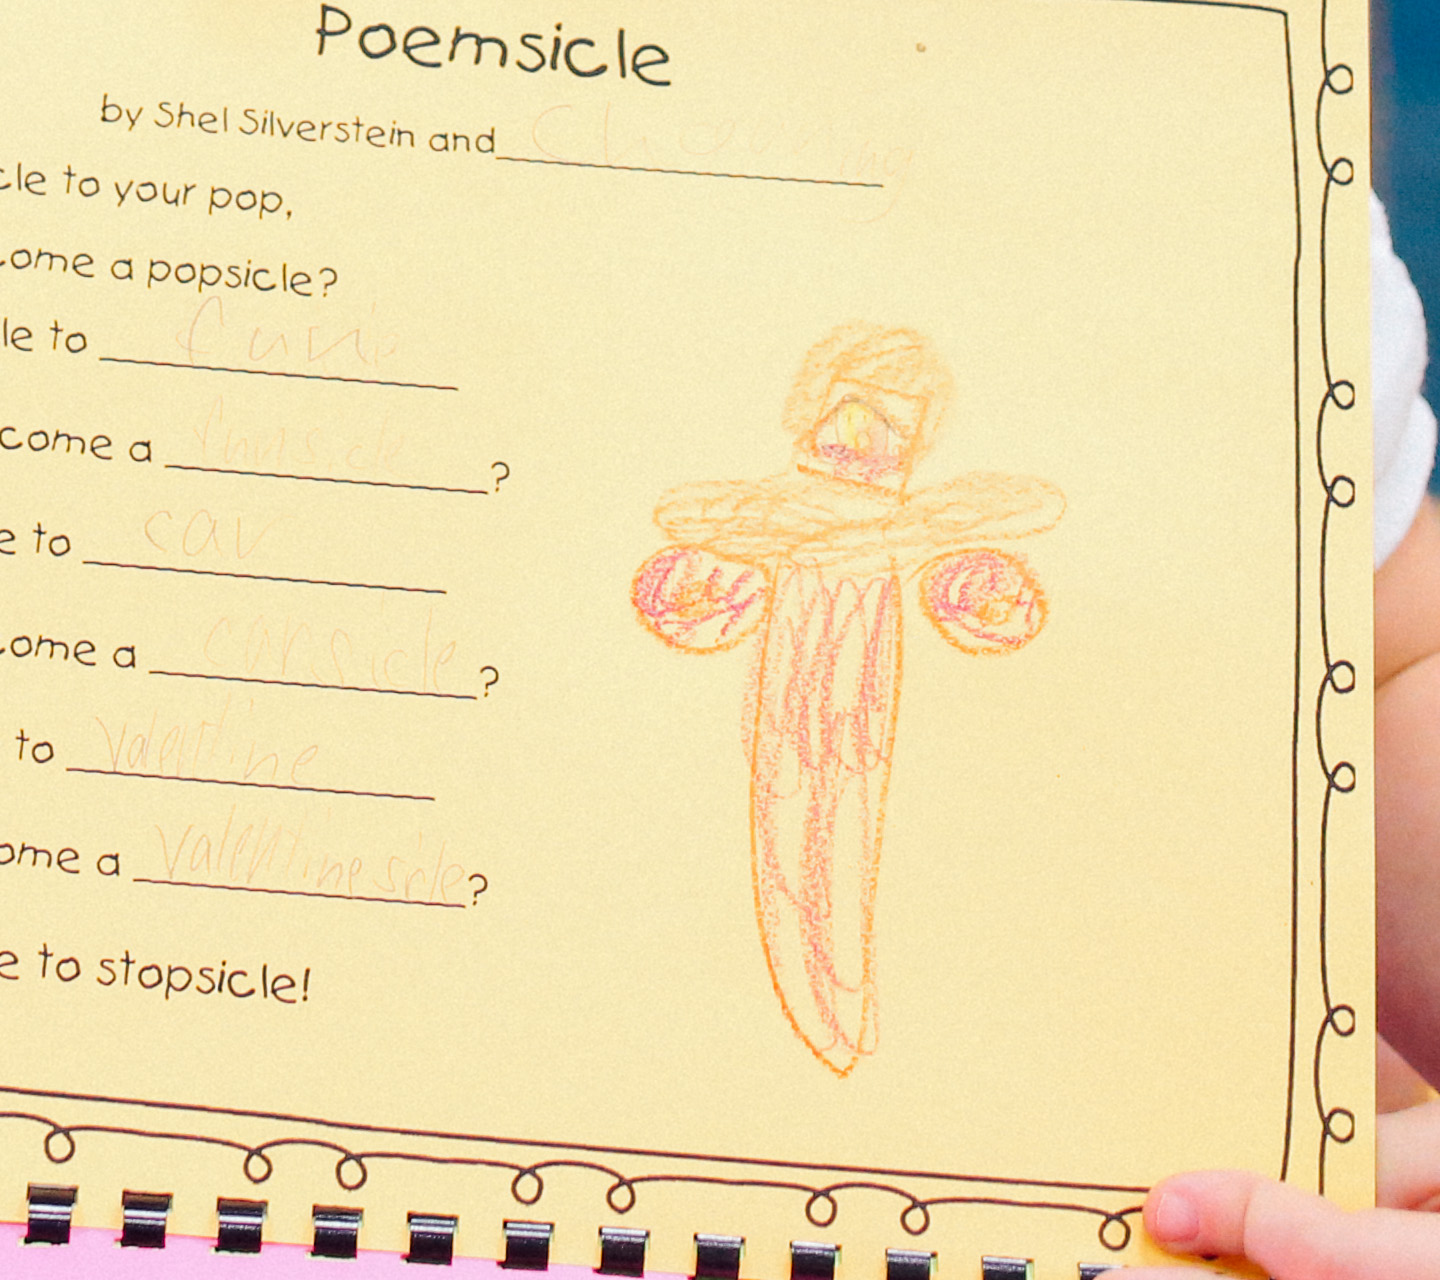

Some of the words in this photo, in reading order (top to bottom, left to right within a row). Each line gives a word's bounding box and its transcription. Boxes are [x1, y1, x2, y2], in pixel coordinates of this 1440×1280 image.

[314, 1, 673, 88] Poemsicle
[99, 92, 145, 133] by
[153, 100, 229, 135] Shel
[237, 107, 416, 149] Silverstein
[427, 126, 497, 155] and
[61, 163, 102, 199] to
[113, 179, 198, 209] your
[207, 185, 294, 221] pop,
[109, 257, 135, 282] a
[146, 257, 339, 299] popsicle?
[48, 318, 89, 355] to
[127, 438, 153, 464] a
[31, 520, 73, 559] to
[111, 643, 138, 670] a
[14, 727, 56, 765] to
[95, 851, 122, 878] a
[36, 941, 83, 984] to
[95, 948, 312, 1006] stopsicle!
